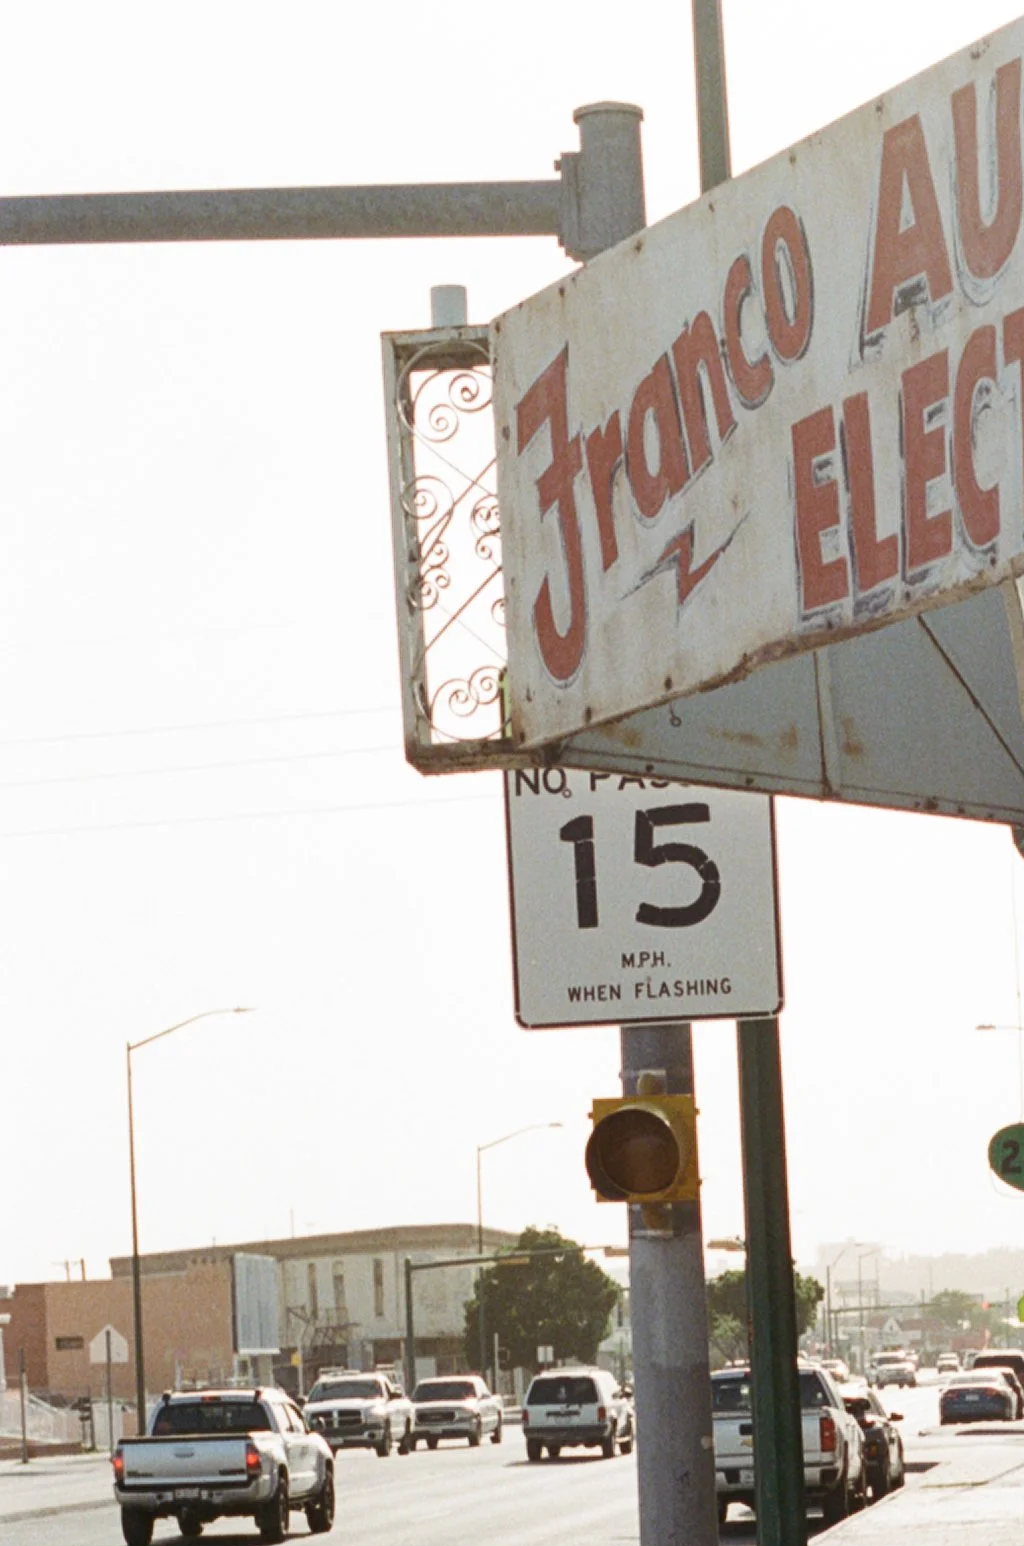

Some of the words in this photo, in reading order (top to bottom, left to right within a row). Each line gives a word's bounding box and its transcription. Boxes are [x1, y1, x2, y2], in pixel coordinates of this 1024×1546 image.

[515, 205, 813, 685] Franco
[515, 767, 567, 796] NO
[560, 803, 721, 929] 15
[567, 983, 622, 1002] WHEN
[634, 977, 732, 999] FLASHING
